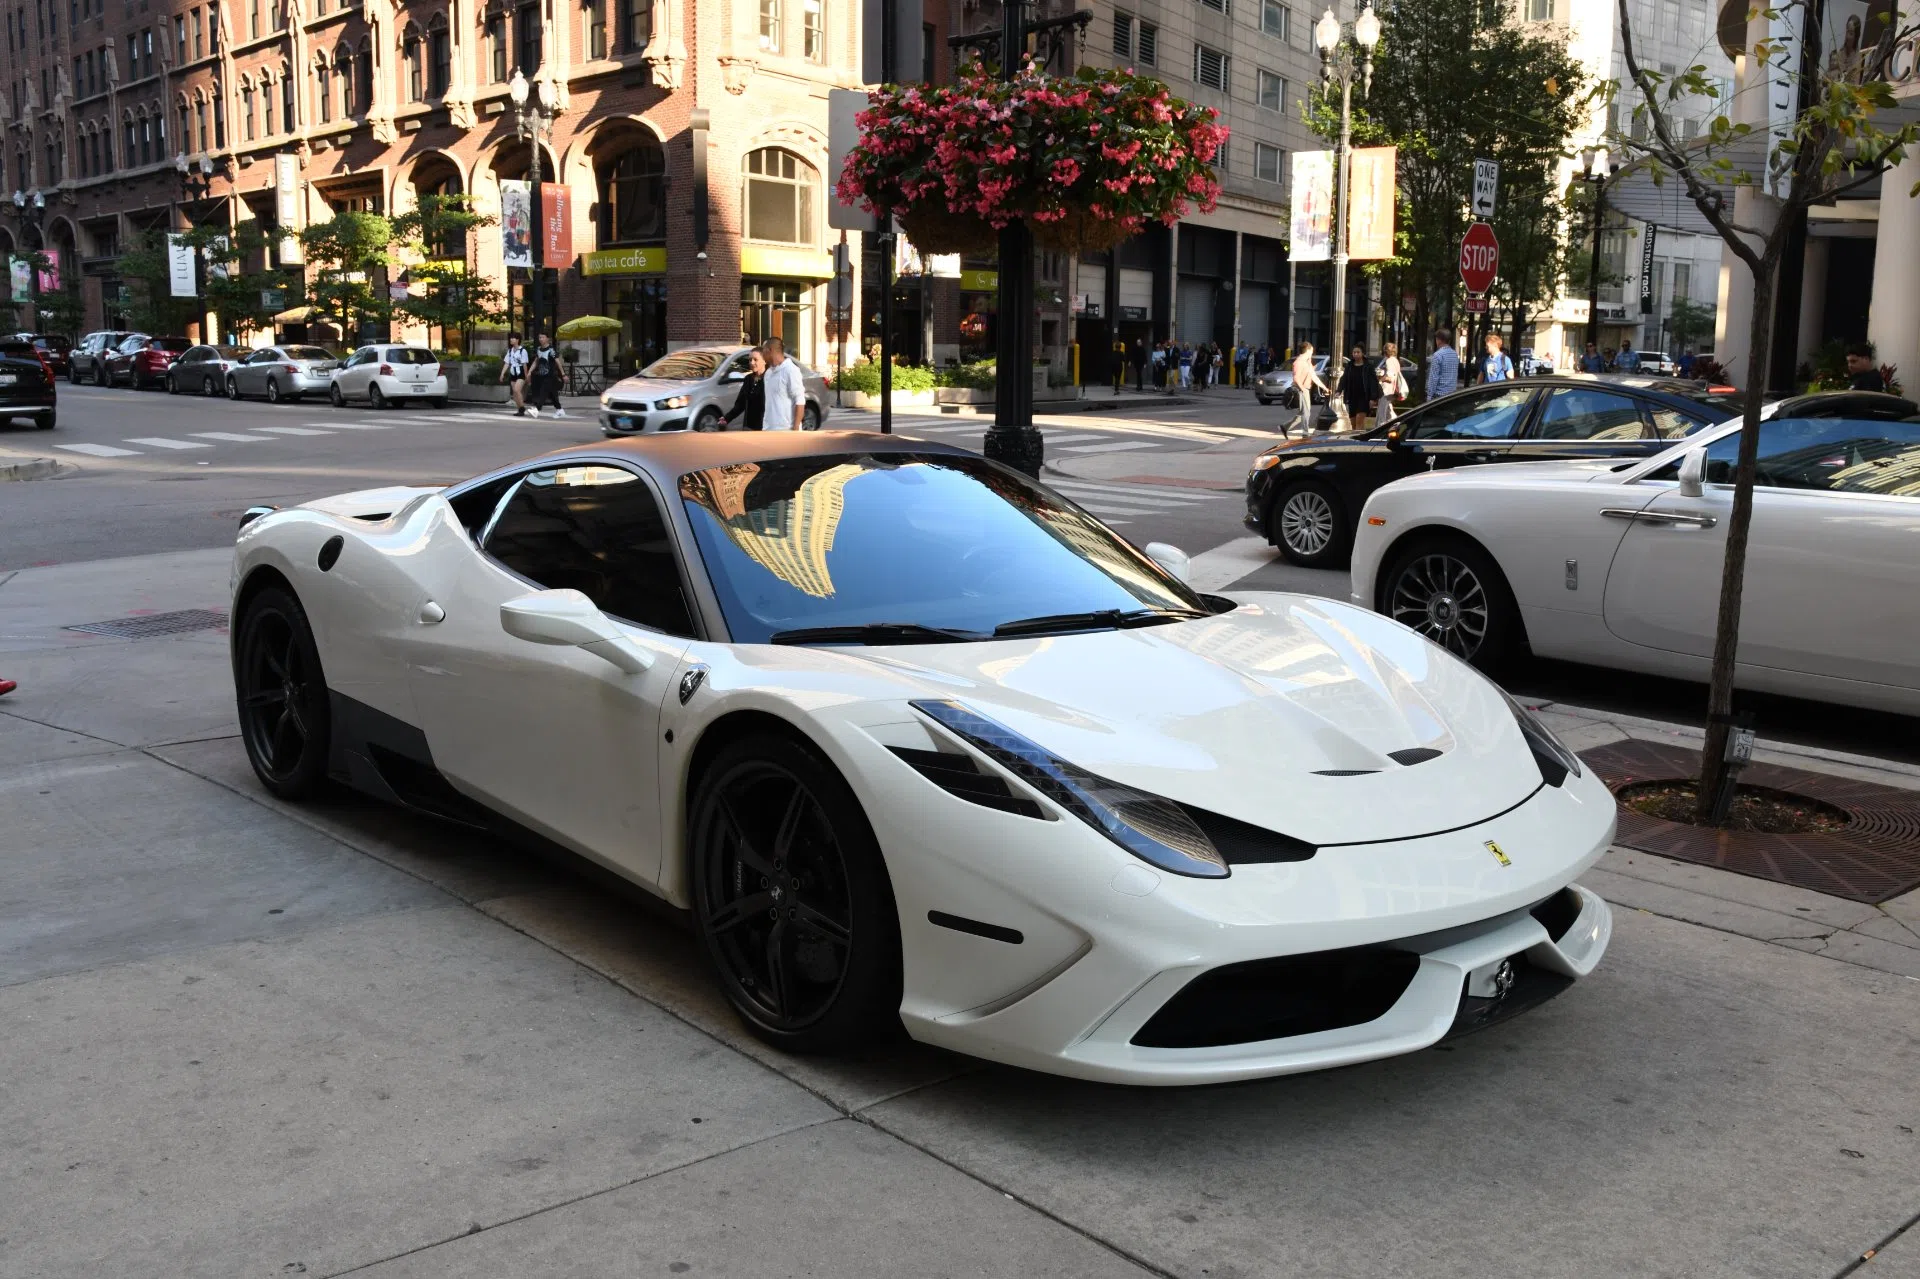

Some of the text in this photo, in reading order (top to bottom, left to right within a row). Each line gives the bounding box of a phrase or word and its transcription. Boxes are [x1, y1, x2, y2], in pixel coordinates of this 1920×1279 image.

[1478, 163, 1496, 180] ONE
[1476, 180, 1495, 195] WAY
[555, 188, 564, 233] Following
[550, 234, 558, 251] Box
[176, 246, 189, 280] LUM
[604, 256, 617, 269] tea
[620, 249, 647, 268] café
[1462, 244, 1497, 272] STOP
[1641, 276, 1651, 298] rack
[1467, 300, 1486, 311] ALL WAY
